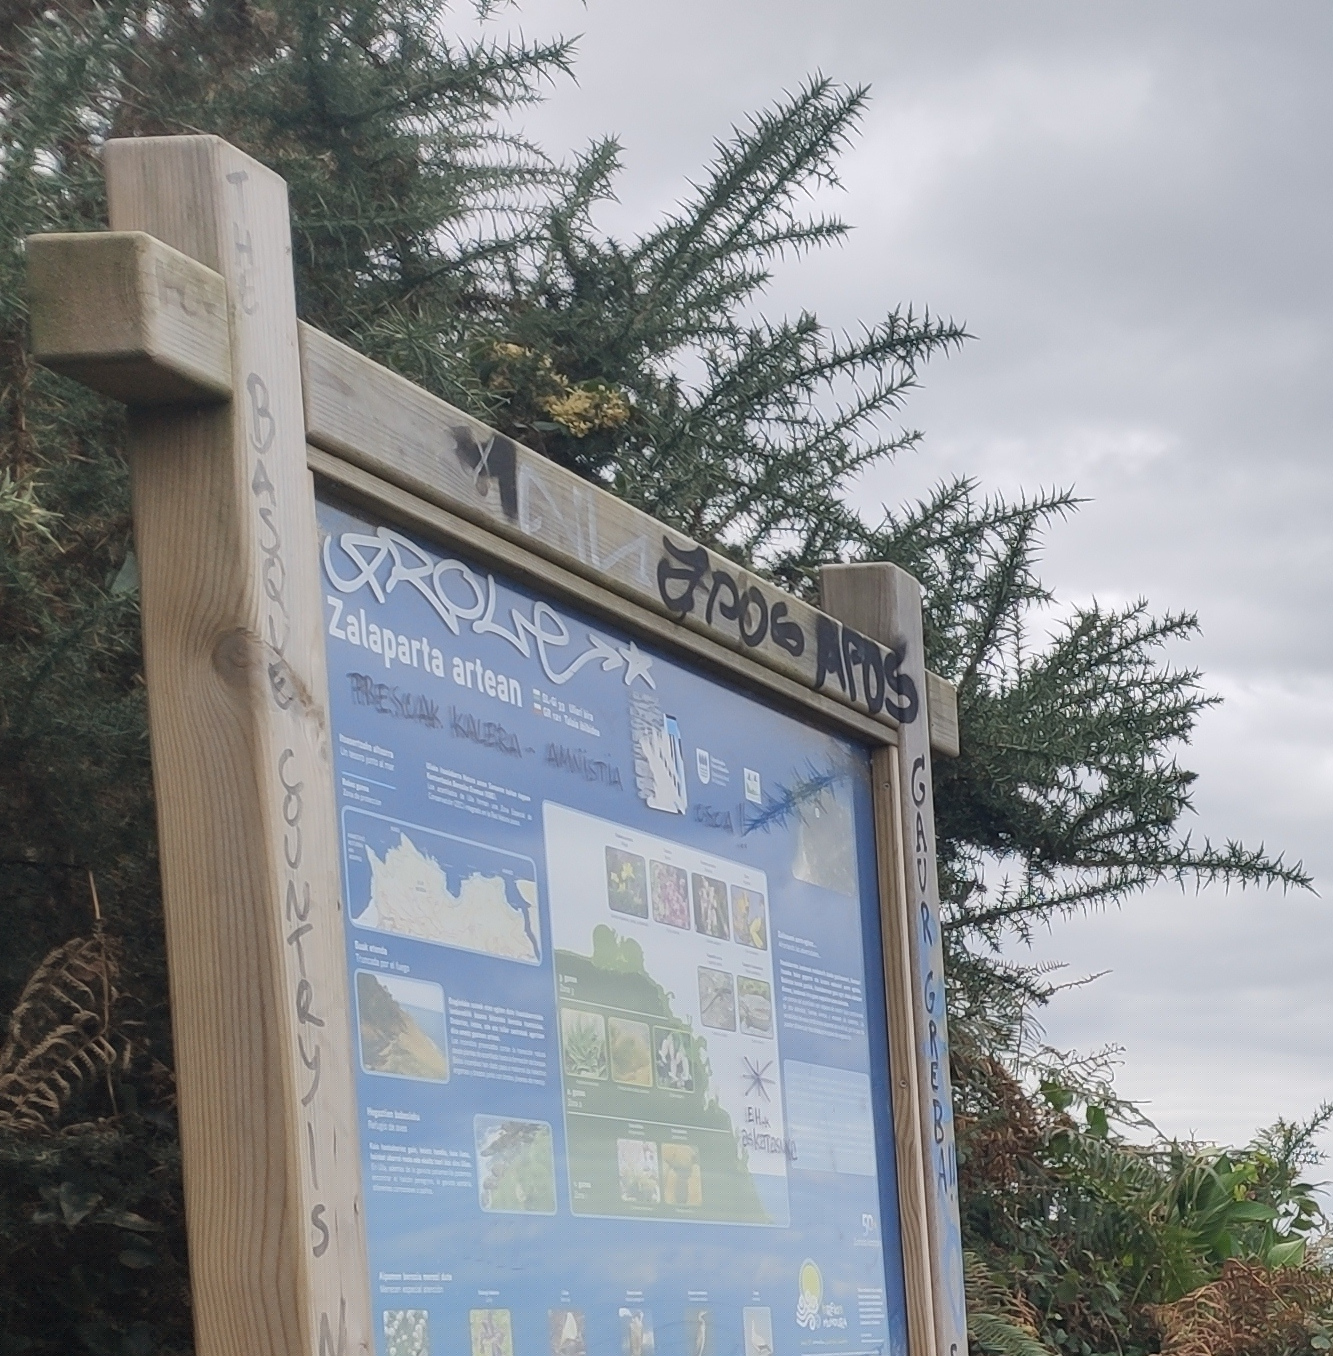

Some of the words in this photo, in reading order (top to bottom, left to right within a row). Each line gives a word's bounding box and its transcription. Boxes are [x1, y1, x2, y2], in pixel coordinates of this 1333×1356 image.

[326, 595, 445, 679] Zalaparta
[453, 655, 522, 707] artean
[246, 372, 295, 711] BASQUE
[278, 748, 326, 1107] COUNTRY
[307, 1121, 330, 1259] IS
[910, 752, 933, 948] GAUR
